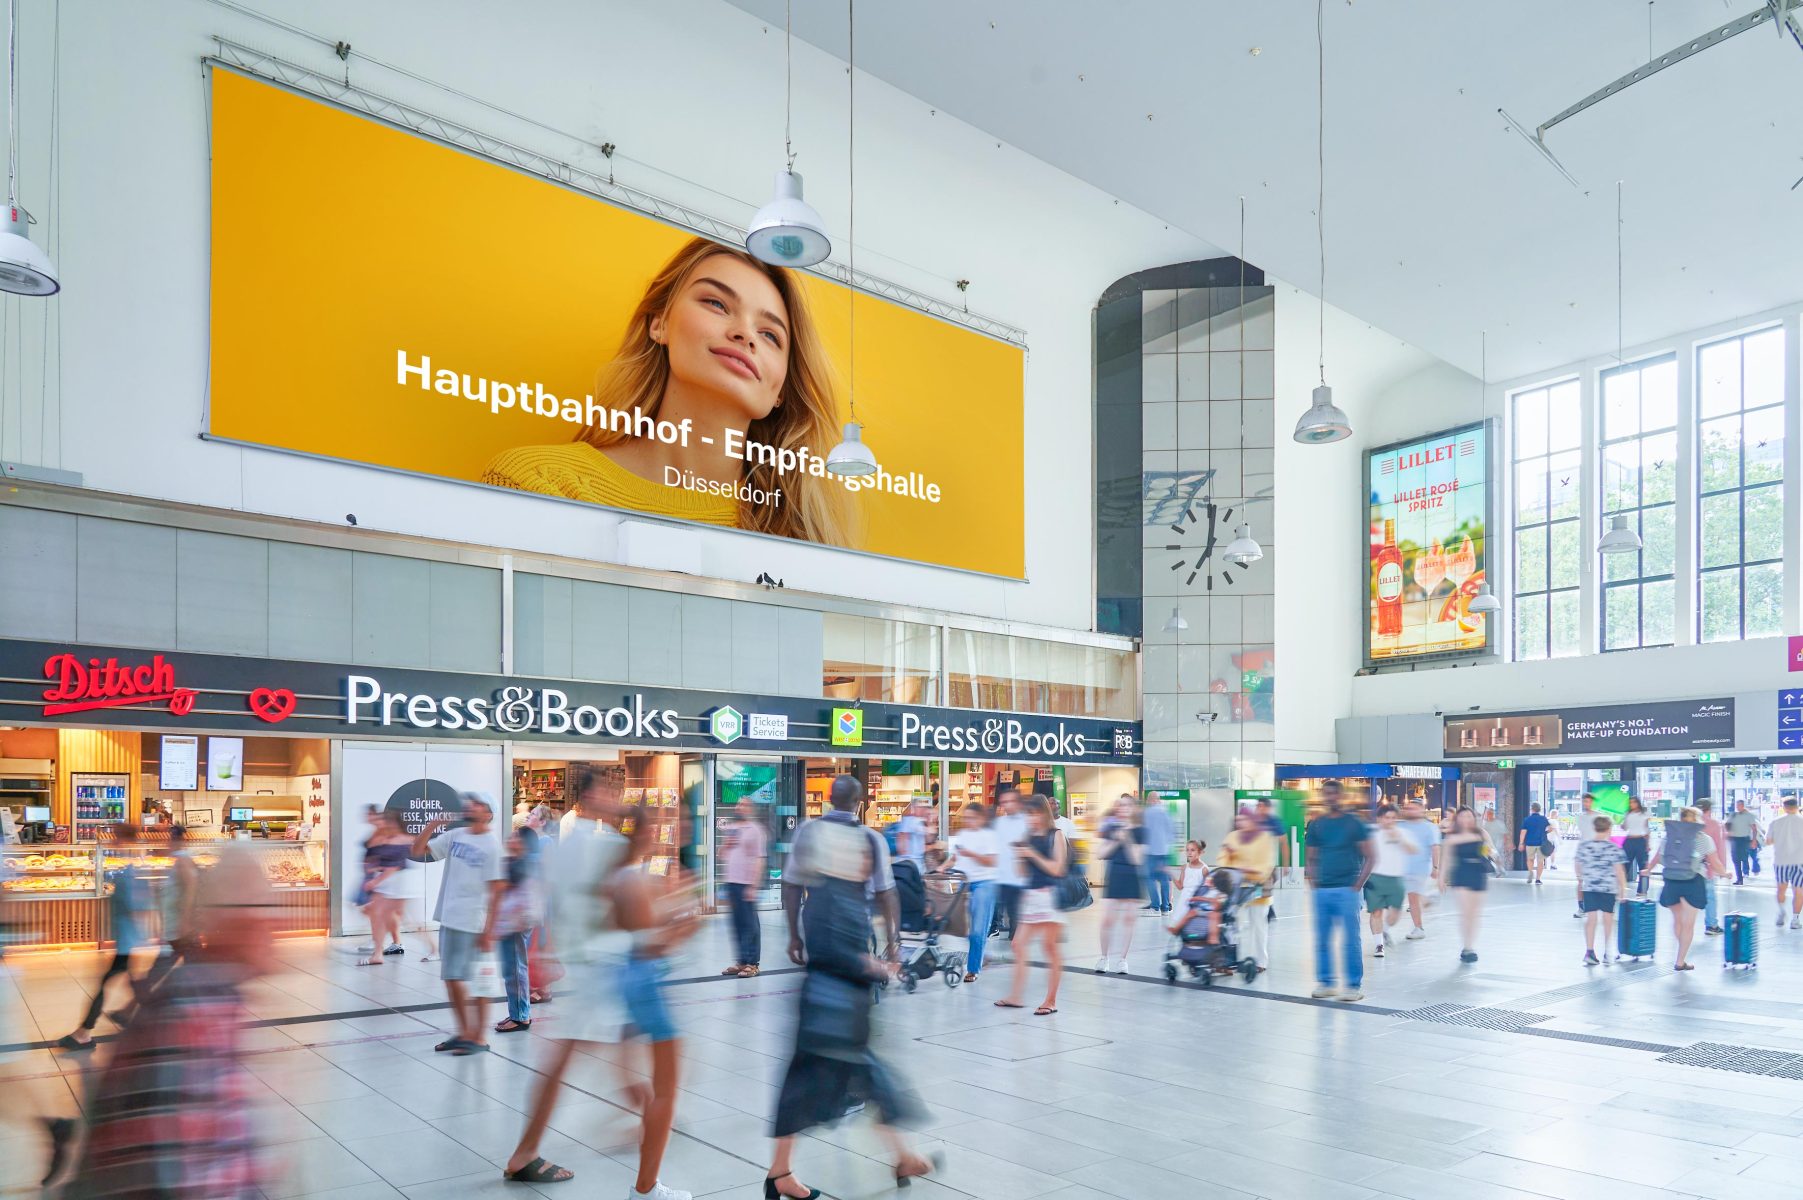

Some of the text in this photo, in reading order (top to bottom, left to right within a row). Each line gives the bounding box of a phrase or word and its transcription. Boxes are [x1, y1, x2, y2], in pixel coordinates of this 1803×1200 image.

[397, 349, 941, 503] Hauptbahnhof - Empfagshalle
[1399, 444, 1456, 470] LILLET
[664, 465, 781, 508] Düsseldorf
[1394, 478, 1459, 504] LILLET ROSÉ
[1409, 496, 1443, 512] SPRITZ
[1379, 575, 1400, 585] LILLET
[43, 654, 174, 700] Ditsch
[347, 675, 680, 739] Press&Books
[720, 721, 736, 729] VRR
[753, 716, 785, 727] Tickets
[1567, 719, 1625, 730] GERMANY'S
[753, 726, 785, 737] Service
[902, 713, 1085, 757] Press&Books
[1567, 726, 1689, 739] MAKE-UP FOUNDATION
[1405, 765, 1442, 779] HAFERKATER
[410, 797, 443, 810] BÜCHER,
